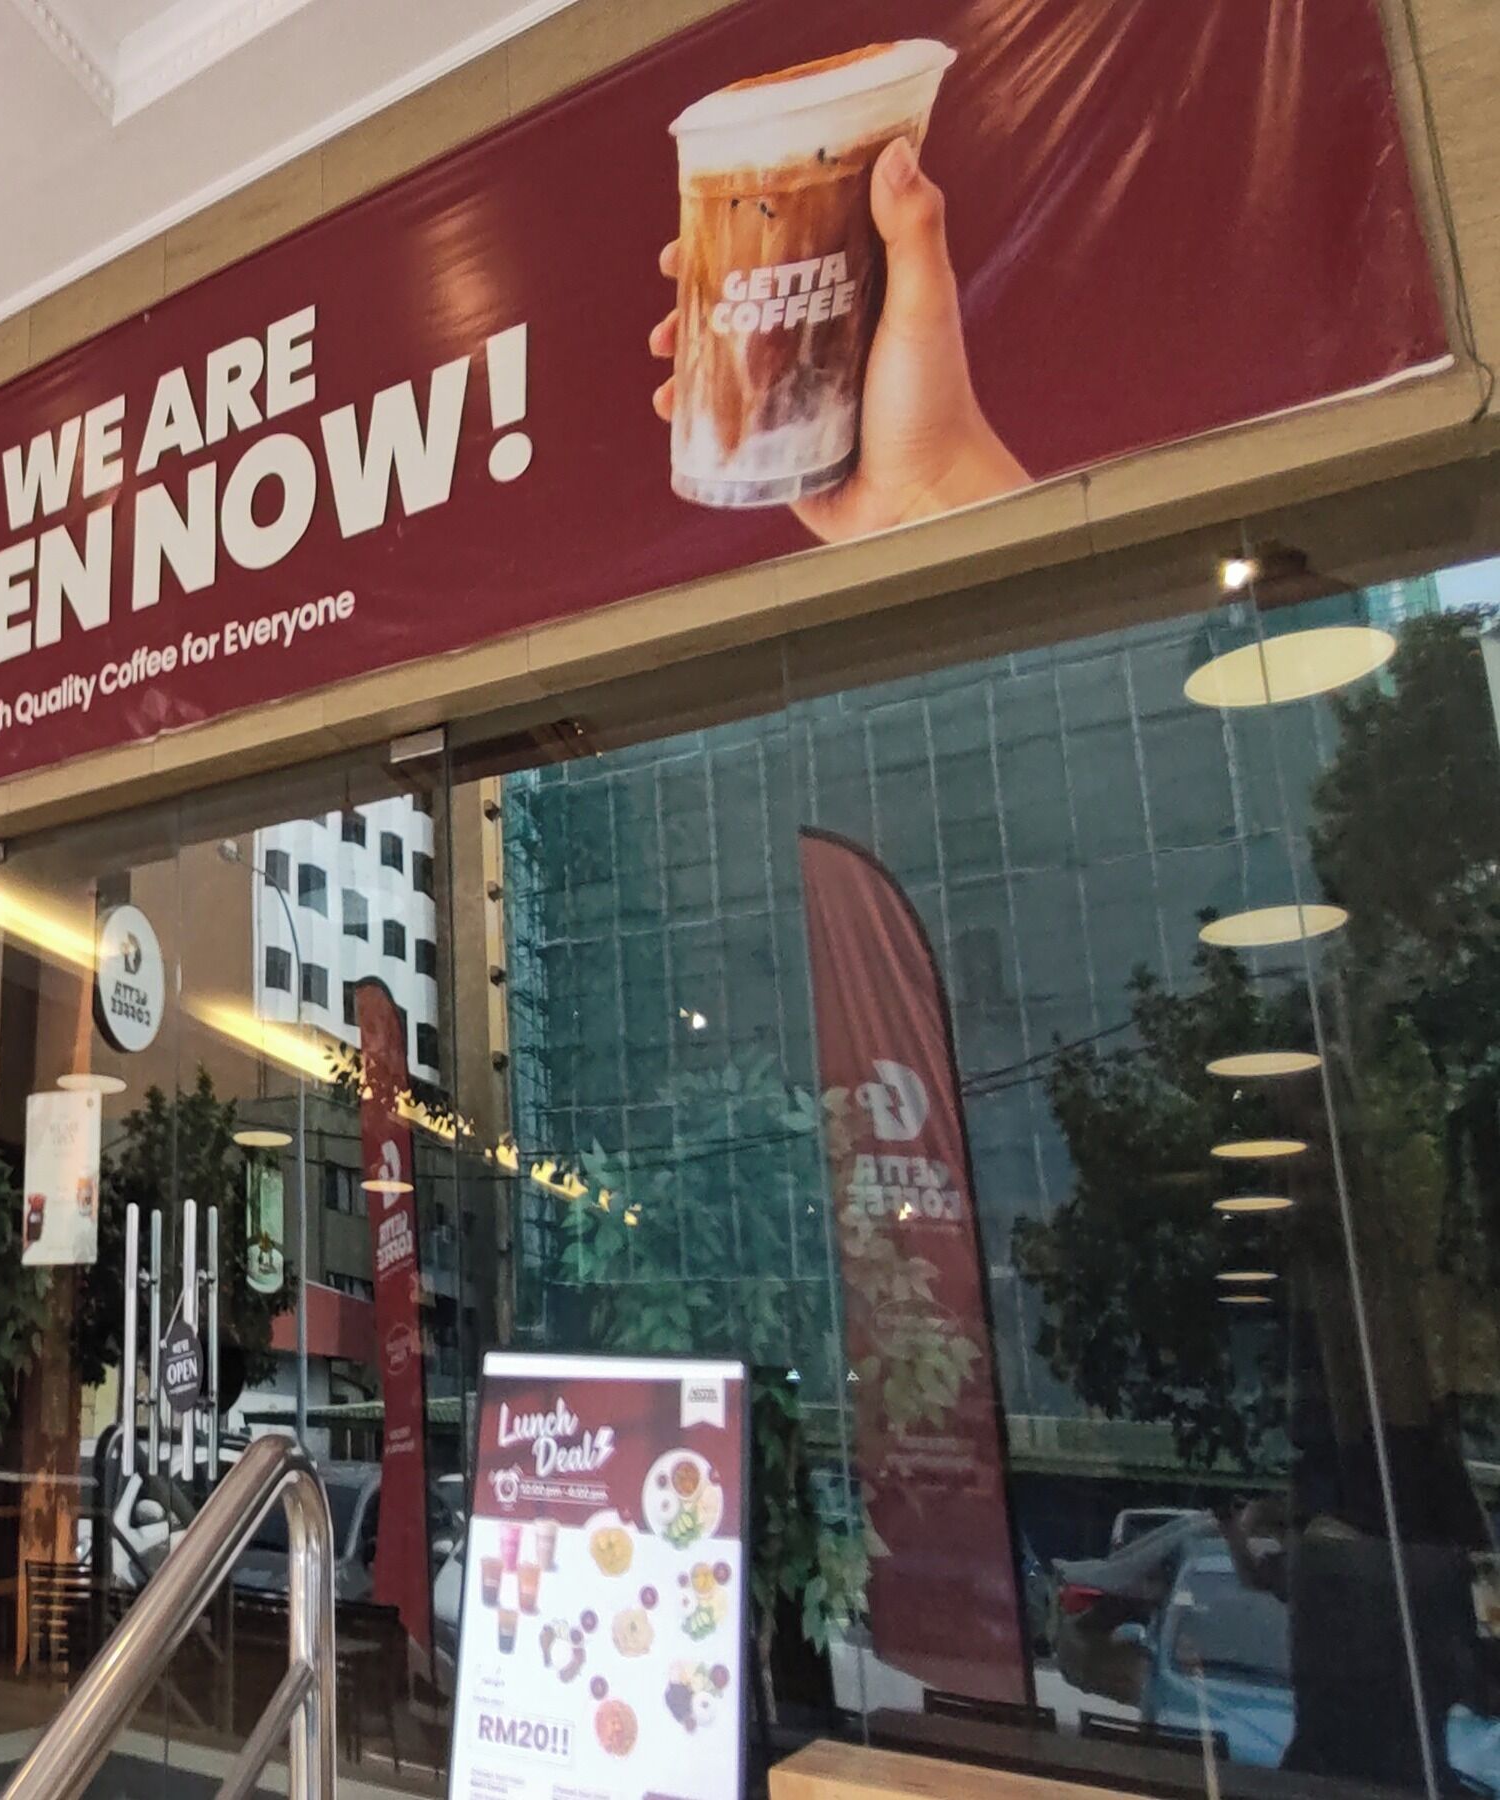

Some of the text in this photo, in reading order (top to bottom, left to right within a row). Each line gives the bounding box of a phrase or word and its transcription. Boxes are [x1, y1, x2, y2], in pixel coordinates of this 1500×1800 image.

[723, 251, 847, 301] GETTA
[711, 280, 856, 335] COFFEE
[2, 305, 316, 530] WE ARE
[132, 322, 533, 613] NOW!
[15, 673, 97, 725] Quality
[100, 644, 178, 695] Coffee
[182, 632, 221, 668] for
[223, 589, 356, 656] Everyone
[166, 1357, 198, 1385] OPEN
[498, 1397, 579, 1447] Lunch
[478, 1713, 569, 1756] RM20!!
